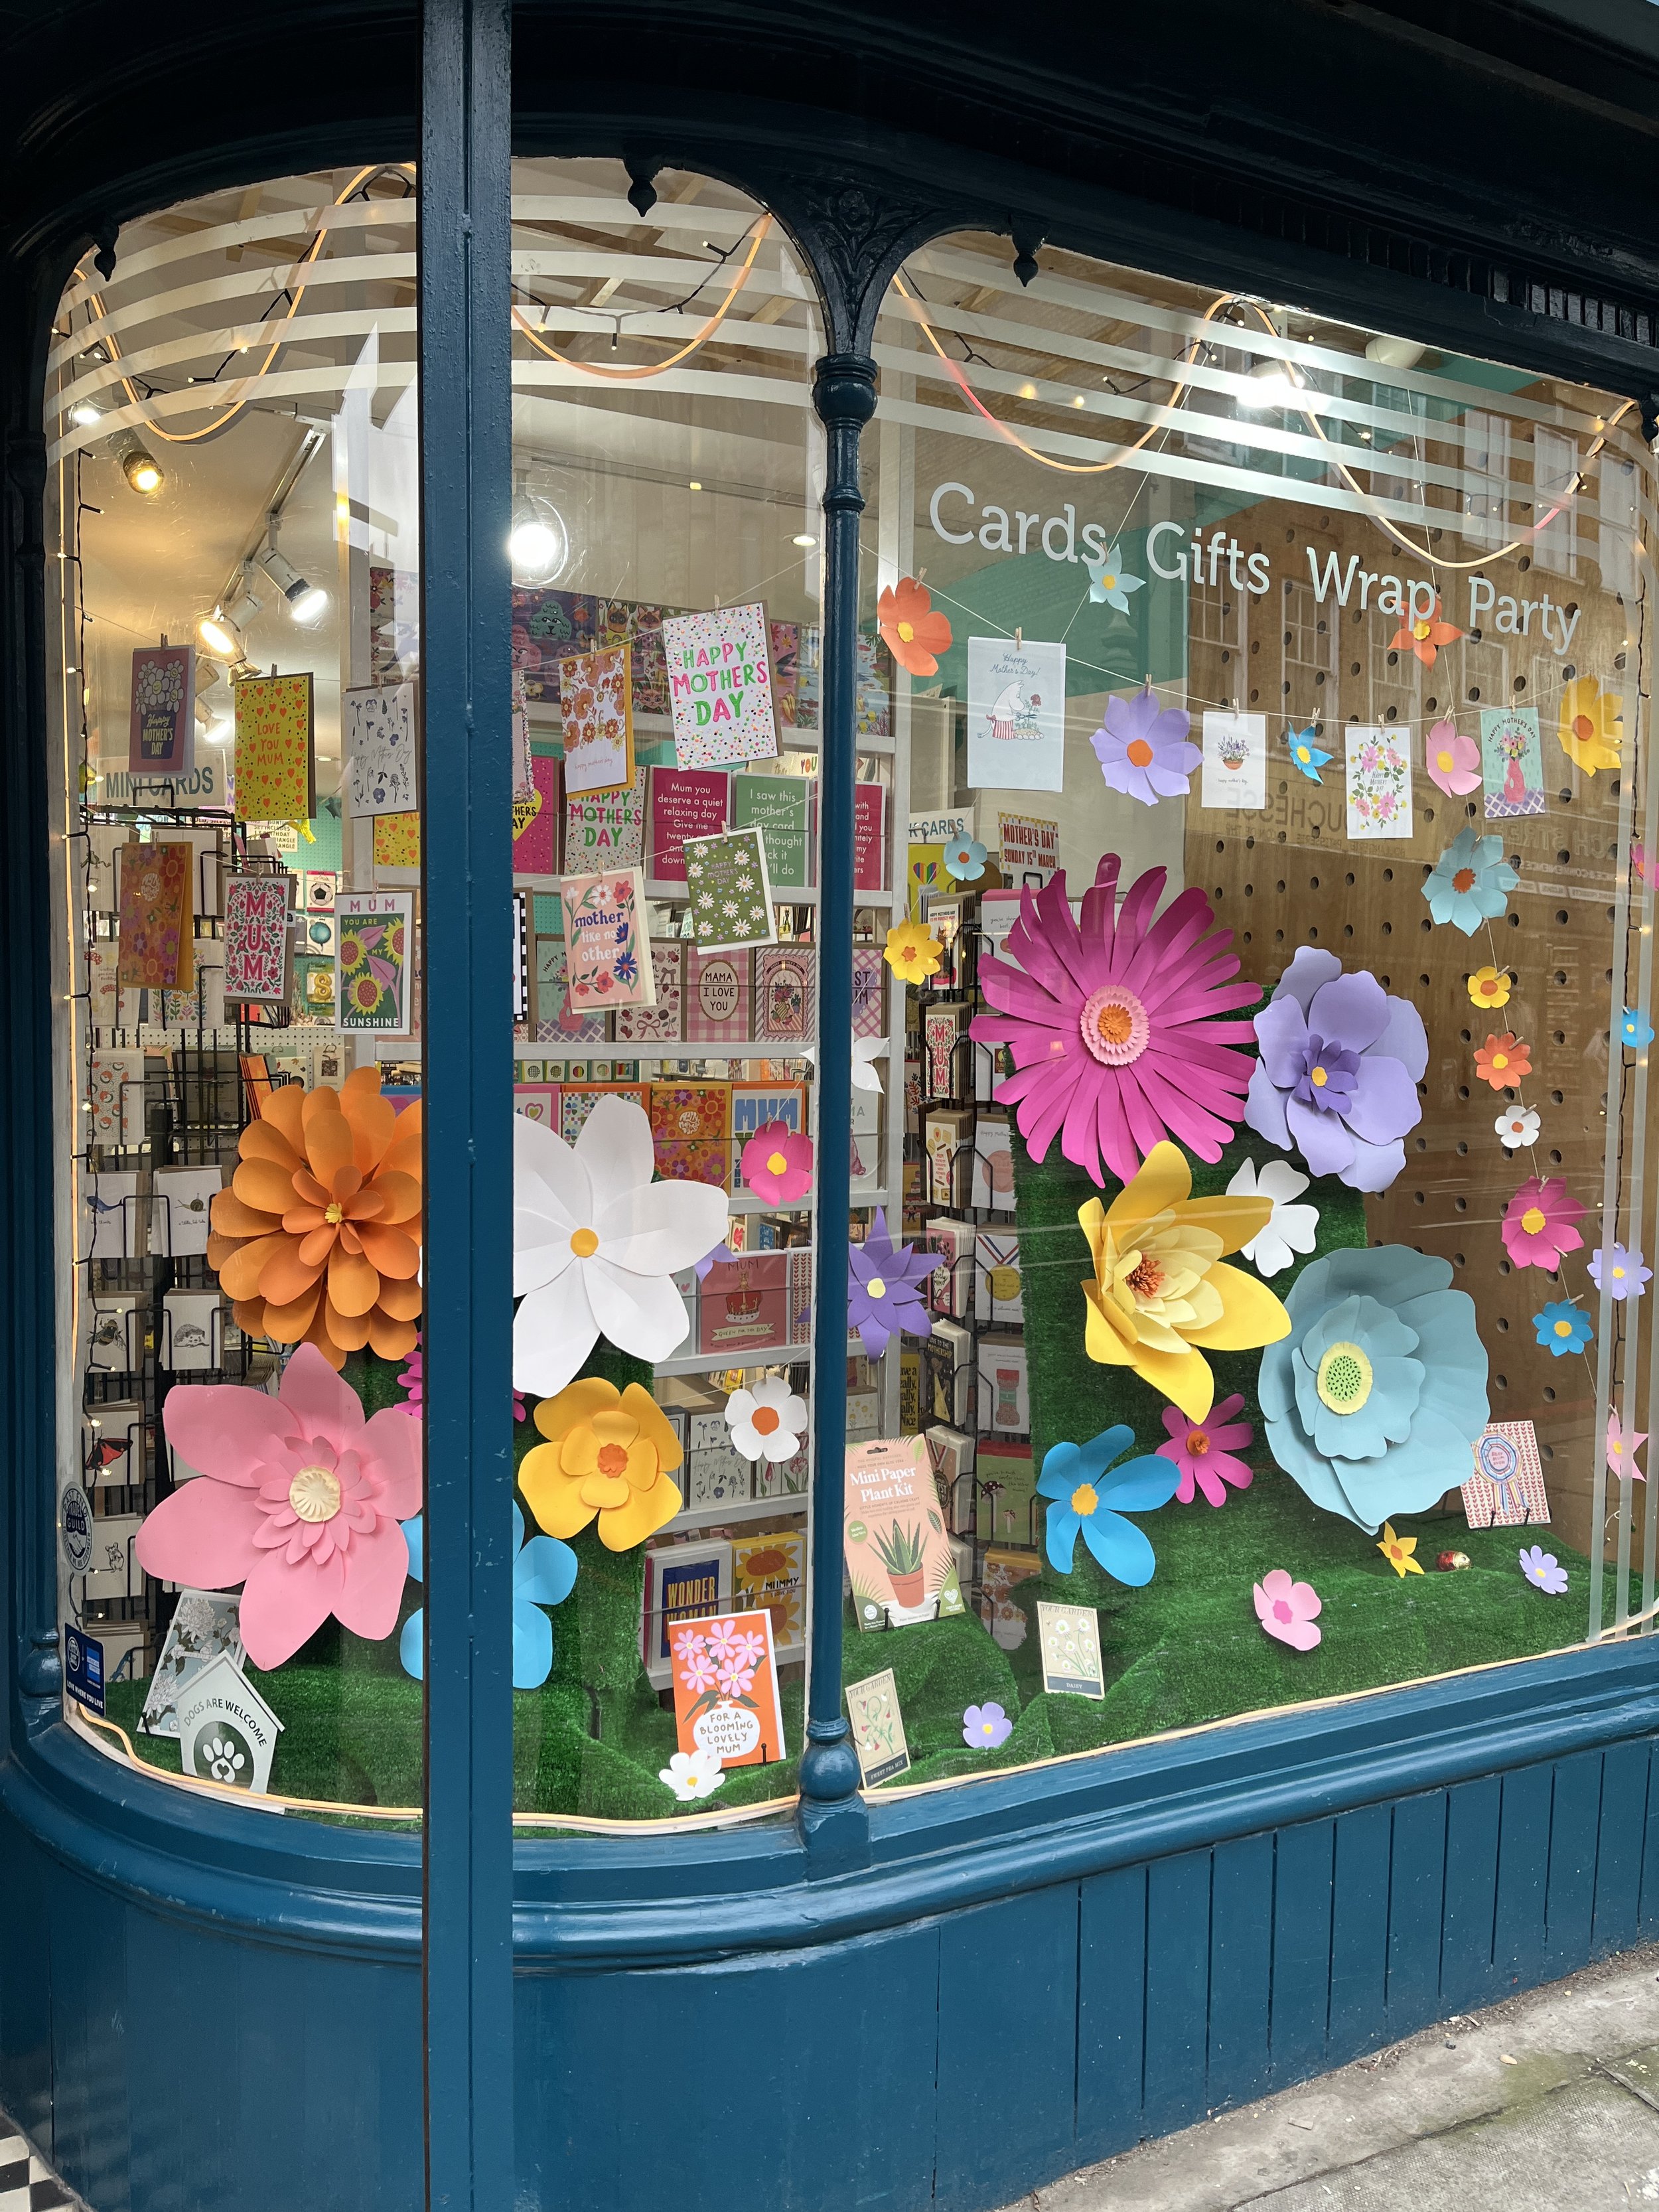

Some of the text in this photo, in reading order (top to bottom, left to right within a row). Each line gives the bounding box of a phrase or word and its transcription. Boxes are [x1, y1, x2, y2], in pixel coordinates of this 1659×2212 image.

[928, 481, 1582, 657] Cards Gifts Wrap Party
[683, 641, 747, 670] HAPPY
[1003, 653, 1028, 666] Happy
[673, 660, 768, 697] MOTHER'S
[693, 690, 744, 726] DAY
[146, 713, 171, 727] Happy
[142, 727, 173, 741] MOTHER'S
[256, 722, 281, 736] LOVE
[1488, 723, 1501, 743] HAPPY
[1527, 727, 1536, 739] DAY
[151, 742, 164, 755] DAY
[260, 738, 279, 751] YOU
[257, 752, 285, 767] MUM
[106, 771, 142, 798] MINI
[149, 766, 214, 797] CARDS
[671, 782, 711, 796] Mum you
[658, 794, 691, 806] deserve
[702, 797, 723, 808] quiet
[750, 788, 796, 802] I saw this
[512, 806, 537, 817] THERS
[751, 804, 794, 817] mother's
[855, 801, 869, 810] with
[570, 803, 642, 826] MOTHER'S
[663, 808, 717, 821] relaxing day
[855, 812, 870, 821] and
[673, 820, 693, 830] Give
[750, 818, 794, 832] day card
[859, 824, 873, 834] you
[921, 818, 964, 837] CARDS
[583, 827, 623, 848] DAY
[765, 834, 803, 849] thought
[1003, 822, 1055, 850] MOTHER'S DAY
[781, 850, 788, 860] it
[856, 846, 867, 855] my
[1004, 848, 1025, 865] SUNDAY
[1038, 853, 1056, 869] MARCH
[711, 861, 732, 871] HAPPY
[781, 863, 794, 875] do
[717, 876, 731, 885] DAY
[350, 899, 396, 913] MUM
[574, 909, 624, 928] mother
[244, 891, 266, 981] MUM
[580, 929, 617, 944] like no
[581, 944, 620, 962] other
[543, 954, 559, 973] HAPPY
[705, 972, 733, 983] MAMA
[703, 987, 735, 997] I LOVE
[709, 1001, 728, 1011] YOU
[342, 1017, 399, 1028] SUNSHINE
[935, 1024, 946, 1086] MUM
[735, 1098, 798, 1132] MUM
[728, 1258, 759, 1272] MUM
[718, 1329, 736, 1338] QUEEN
[927, 1343, 954, 1360] MOTHERSHIP
[901, 1367, 911, 1376] ave
[901, 1379, 917, 1390] eally,
[849, 1466, 916, 1487] Mini Paper
[860, 1482, 914, 1503] Plant Kit
[66, 1517, 85, 1531] GUILD
[765, 1576, 800, 1591] MUMMY
[667, 1576, 716, 1609] WONDER
[1041, 1605, 1094, 1617] YOUR GARDEN
[849, 1674, 892, 1699] YOUR GARDEN
[183, 1698, 267, 1747] DOGS ARE WELCOME
[709, 1711, 741, 1724] FOR A
[699, 1720, 754, 1735] BLOOMING
[707, 1732, 748, 1745] LOVELY
[716, 1743, 741, 1755] MUM
[870, 1759, 904, 1781] SWEET PEA MIX
